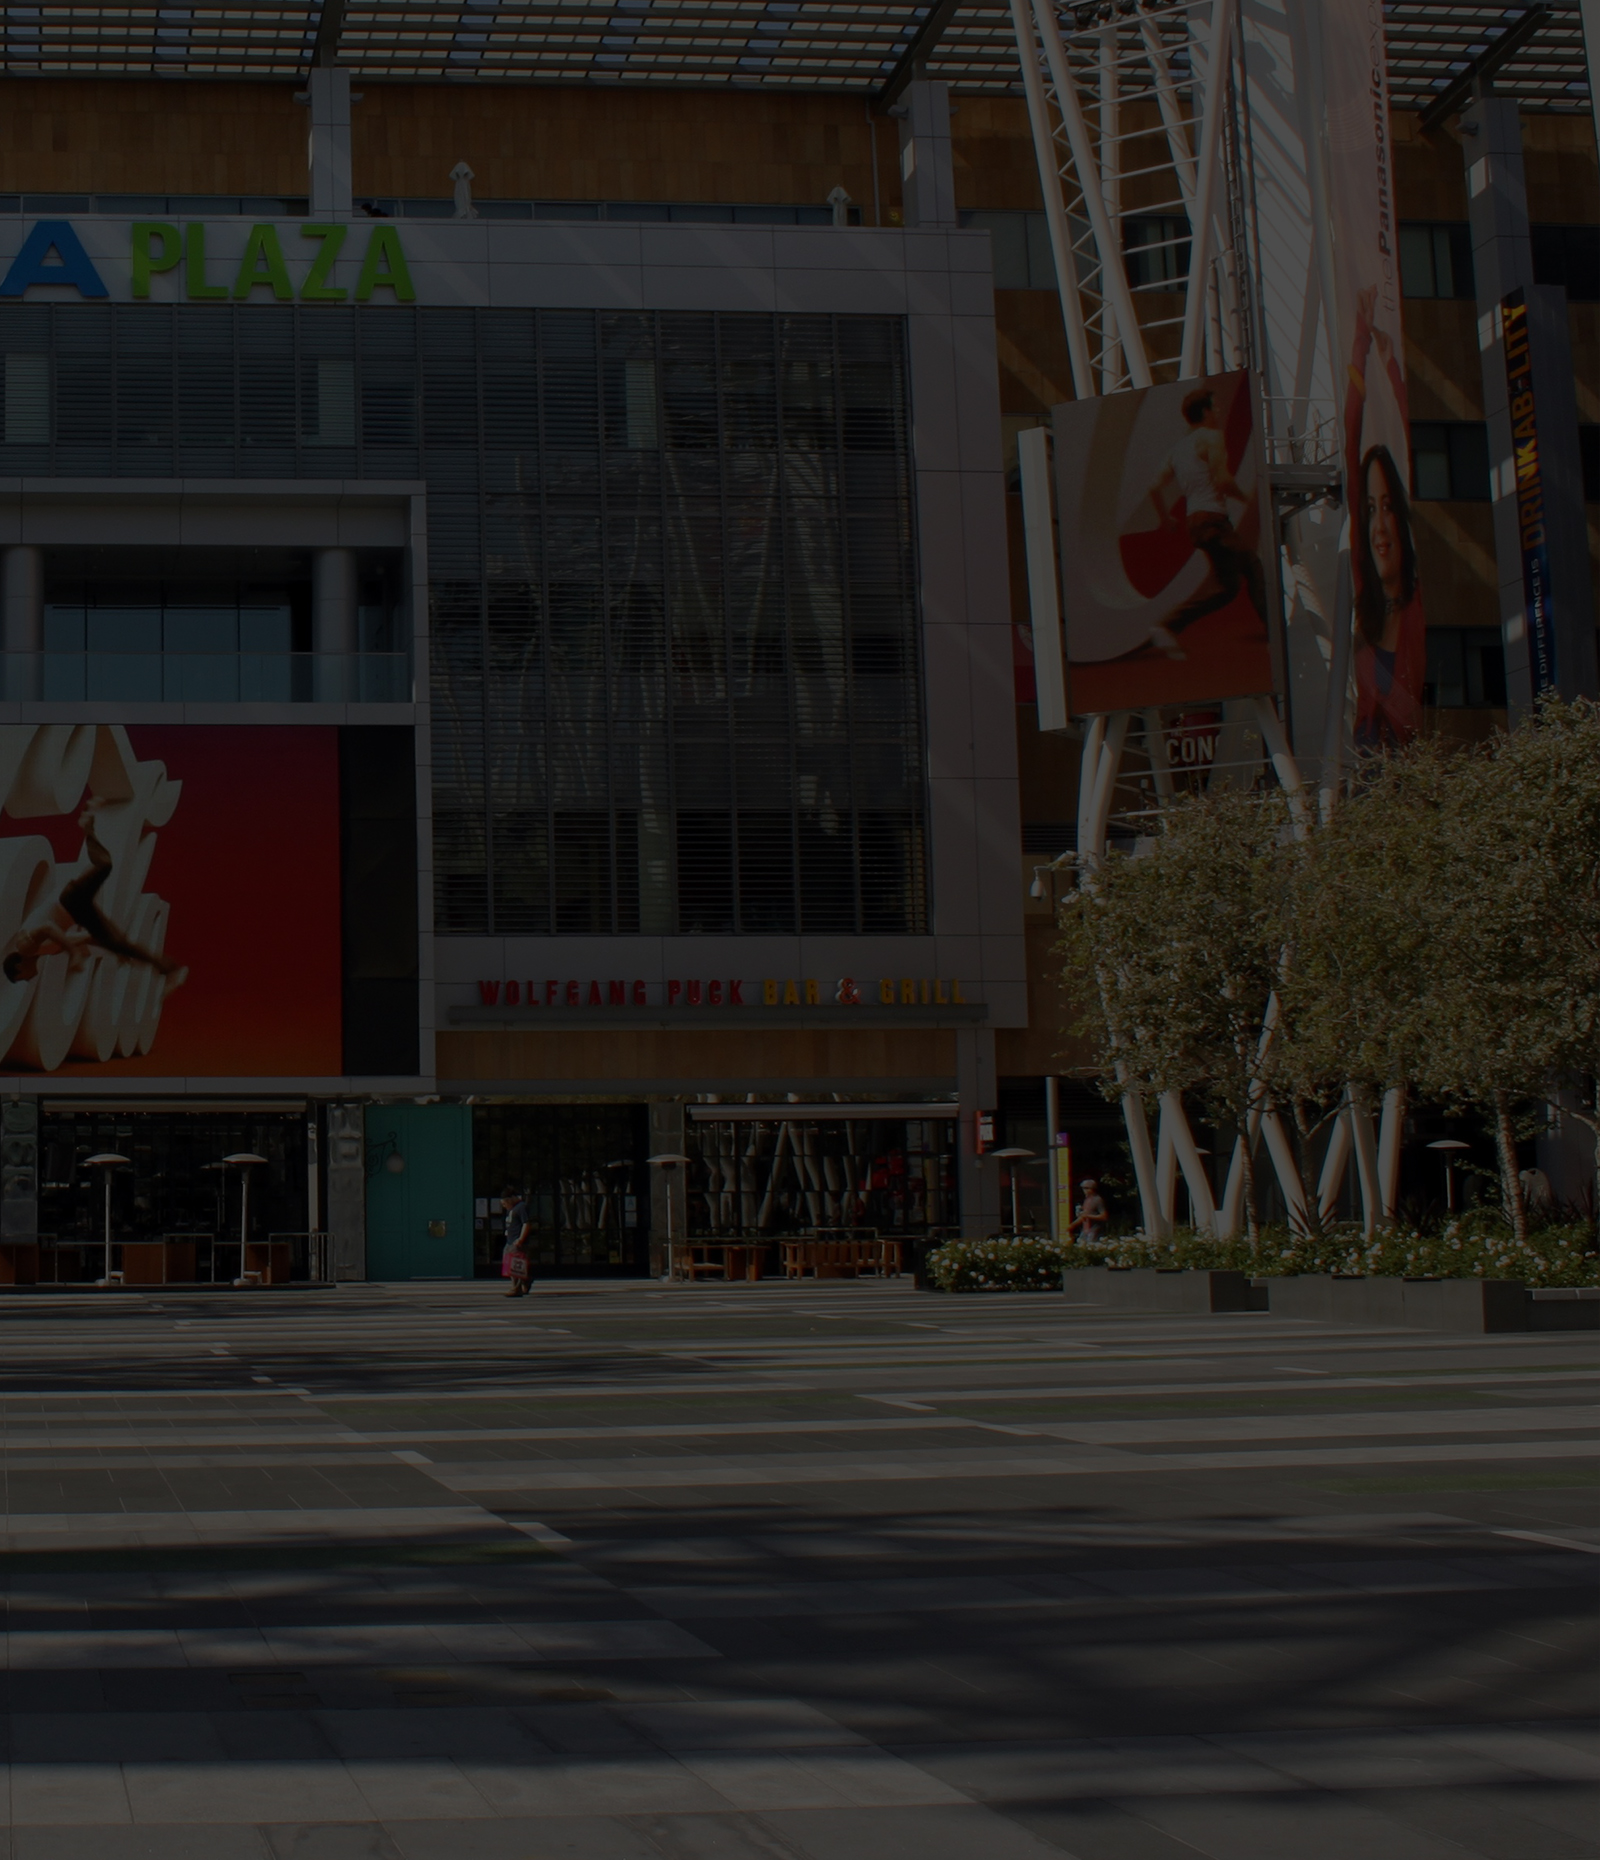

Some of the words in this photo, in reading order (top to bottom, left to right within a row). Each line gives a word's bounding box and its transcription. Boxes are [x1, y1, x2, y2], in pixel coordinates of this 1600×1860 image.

[131, 222, 417, 301] PLAZA
[1530, 558, 1540, 574] IS
[1532, 576, 1549, 675] DIFFERENCE
[478, 980, 647, 1006] WOLFGANG
[667, 979, 744, 1005] PUCK
[763, 978, 821, 1005] BAR
[834, 977, 862, 1005] &
[879, 977, 967, 1005] GRILL
